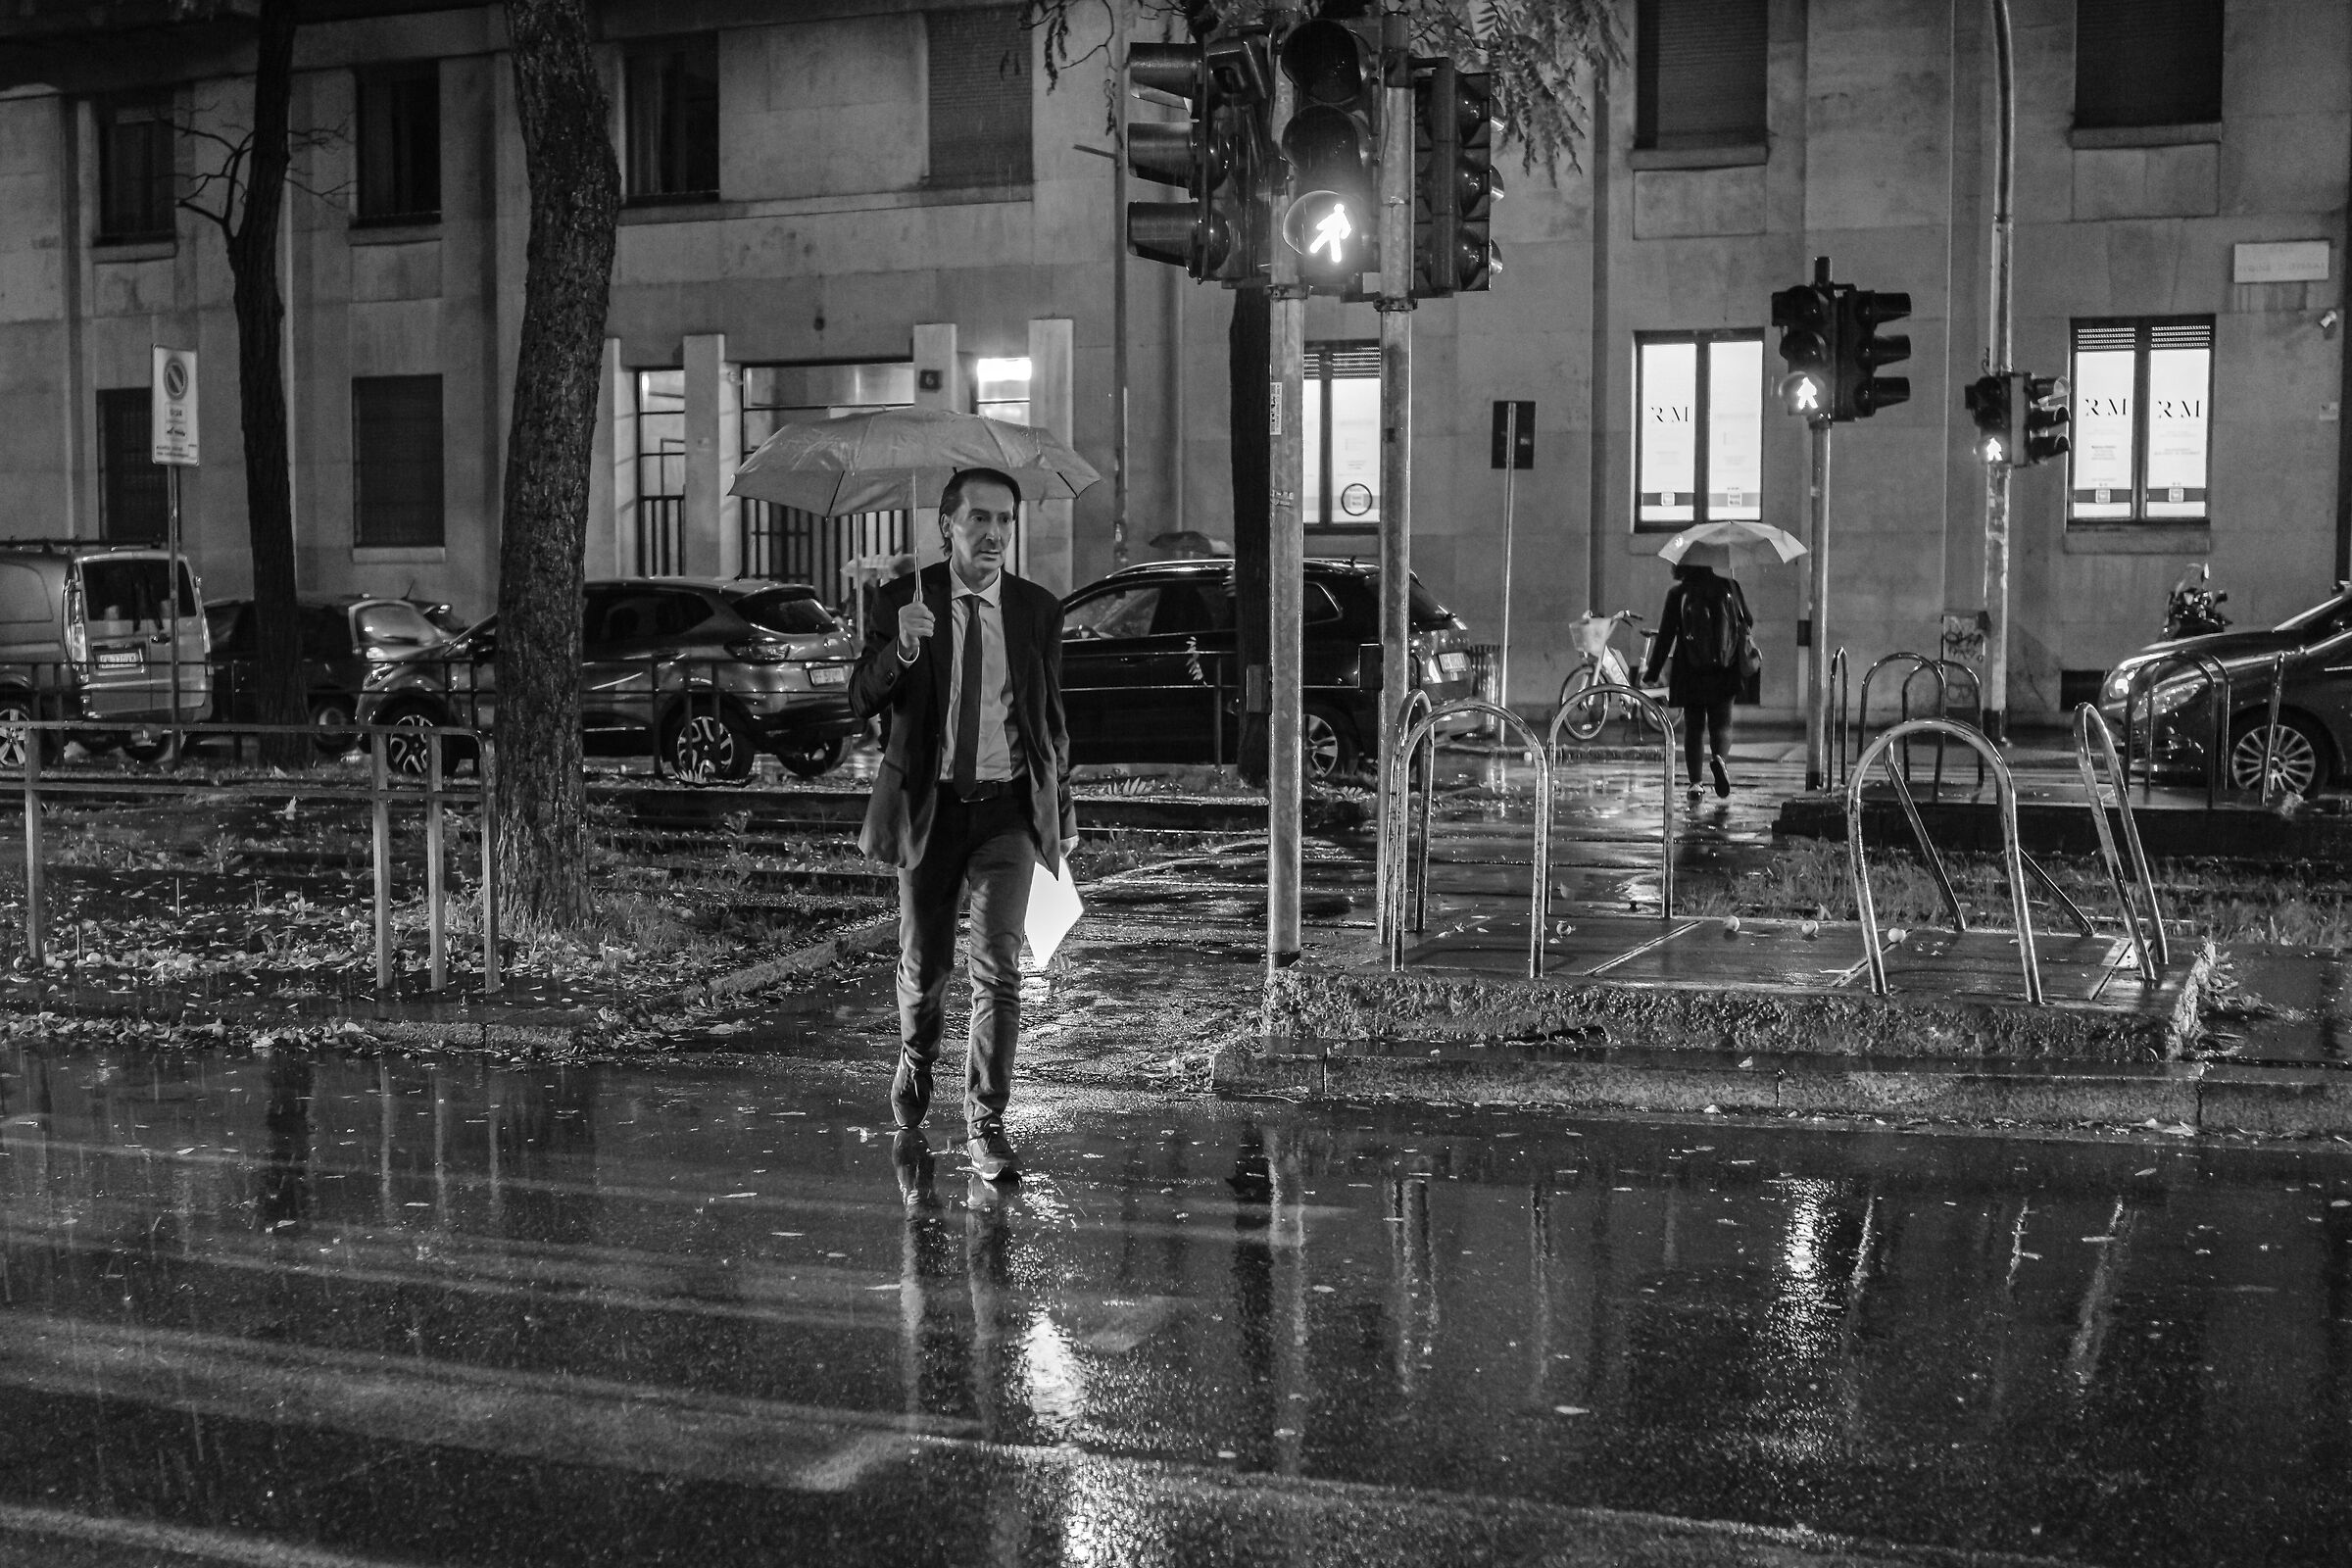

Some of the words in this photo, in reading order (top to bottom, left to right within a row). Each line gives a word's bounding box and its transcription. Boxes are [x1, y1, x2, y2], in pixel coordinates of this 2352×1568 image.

[1650, 407, 1688, 422] RM
[2084, 398, 2126, 416] RM
[2158, 400, 2199, 418] RM
